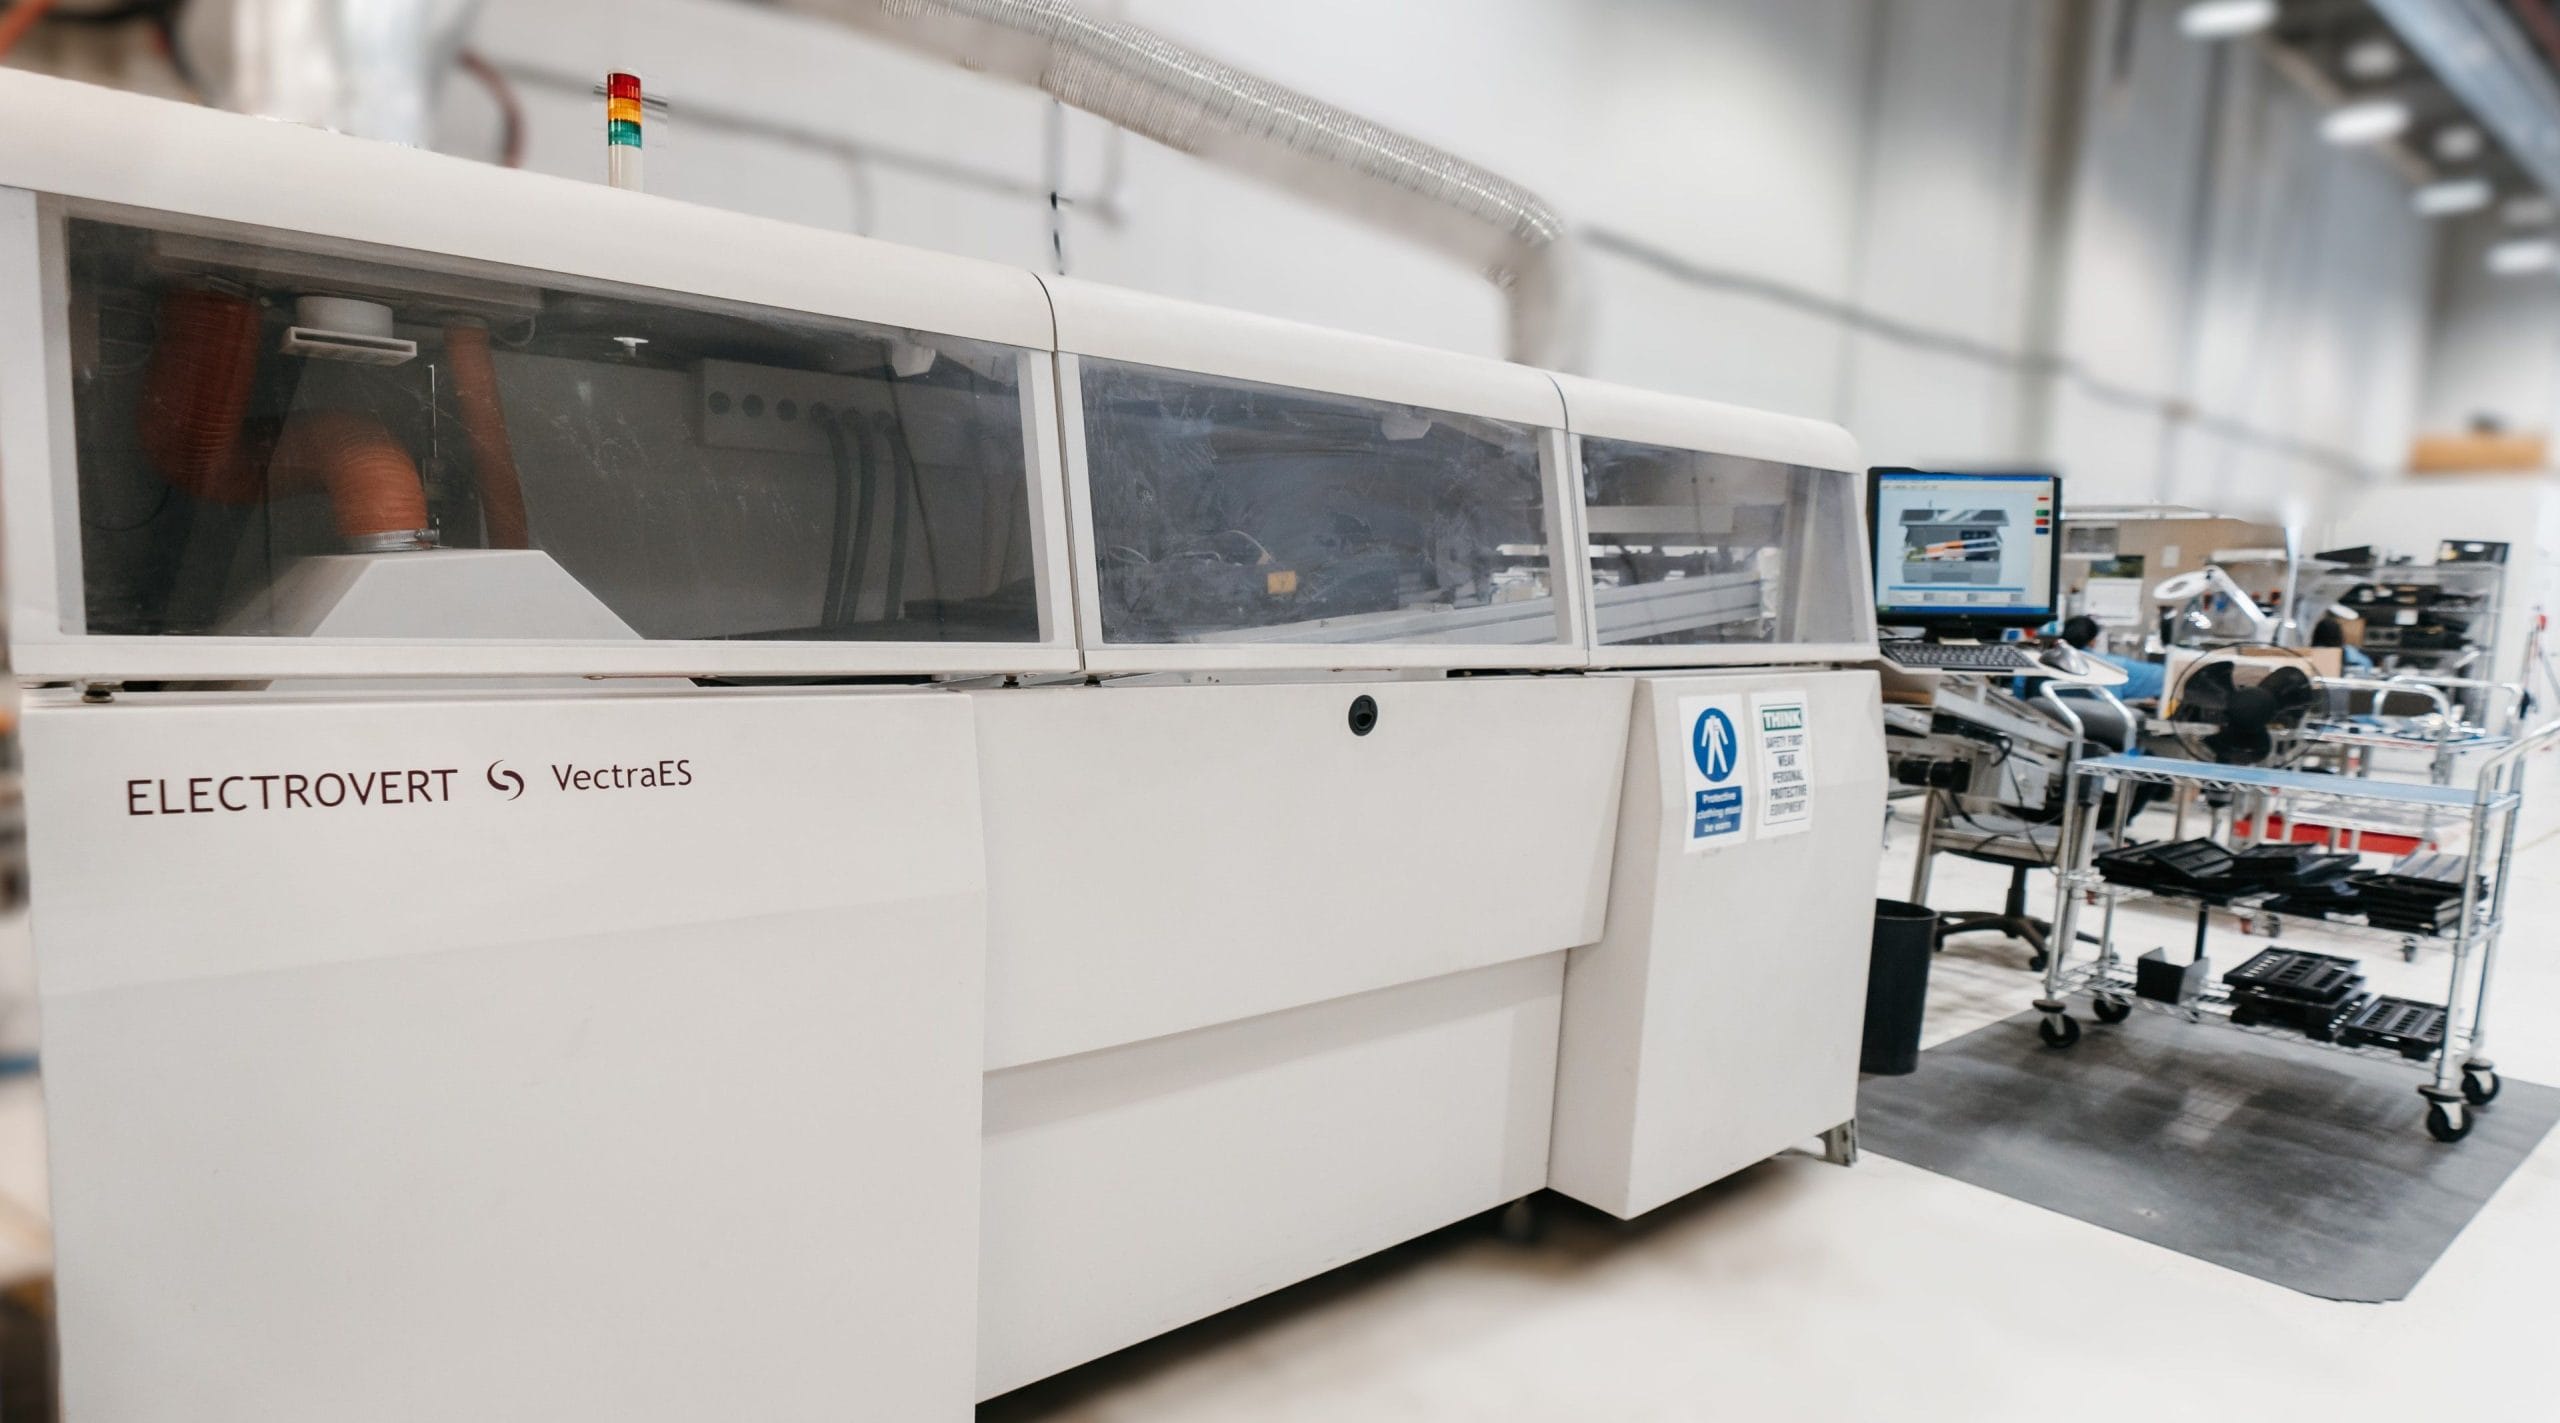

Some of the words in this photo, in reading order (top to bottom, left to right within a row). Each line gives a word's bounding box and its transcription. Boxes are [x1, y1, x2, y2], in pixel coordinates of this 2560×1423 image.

[1763, 711, 1802, 728] THINK
[1766, 736, 1785, 748] SAFETY
[1778, 754, 1795, 766] WEAR
[552, 760, 691, 790] VectraES
[1772, 770, 1804, 783] PERSONAL
[128, 769, 457, 815] ELECTROVERT
[1770, 785, 1807, 800] PROTECTIVE
